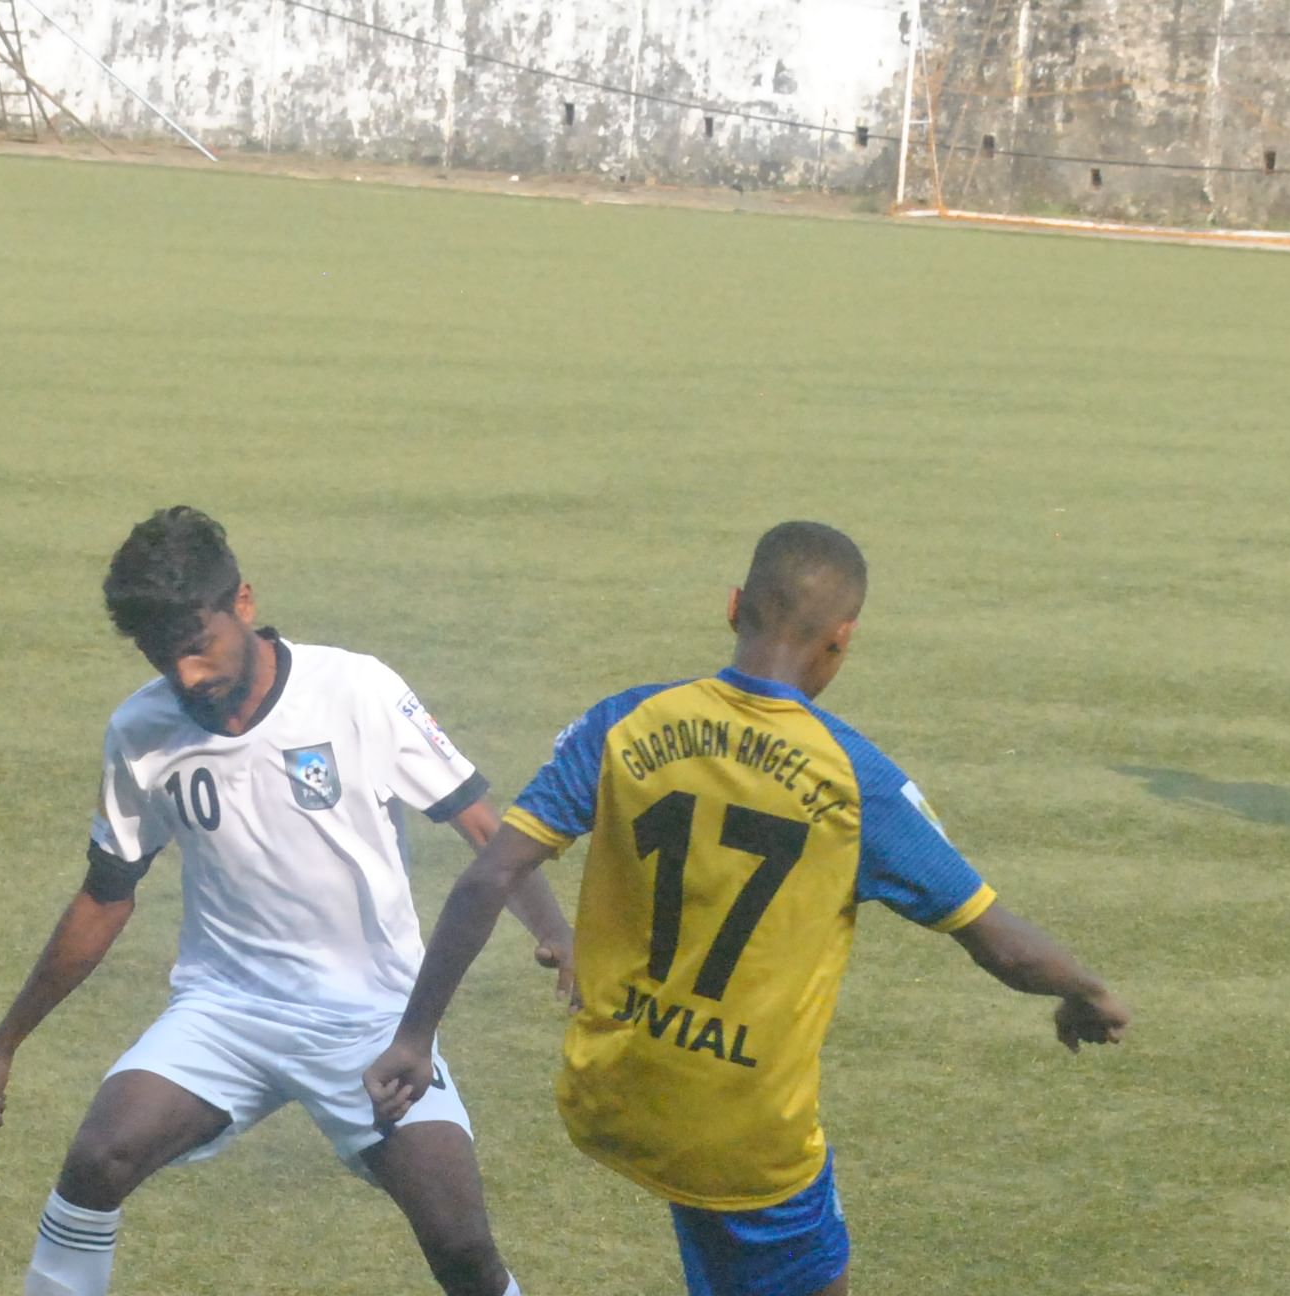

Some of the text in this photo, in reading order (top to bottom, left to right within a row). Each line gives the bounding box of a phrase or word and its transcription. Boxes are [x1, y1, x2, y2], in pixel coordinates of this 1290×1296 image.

[622, 719, 730, 781] GUARDIAN
[735, 726, 810, 791] ANGEL
[165, 767, 221, 831] 10
[632, 790, 809, 1001] 17
